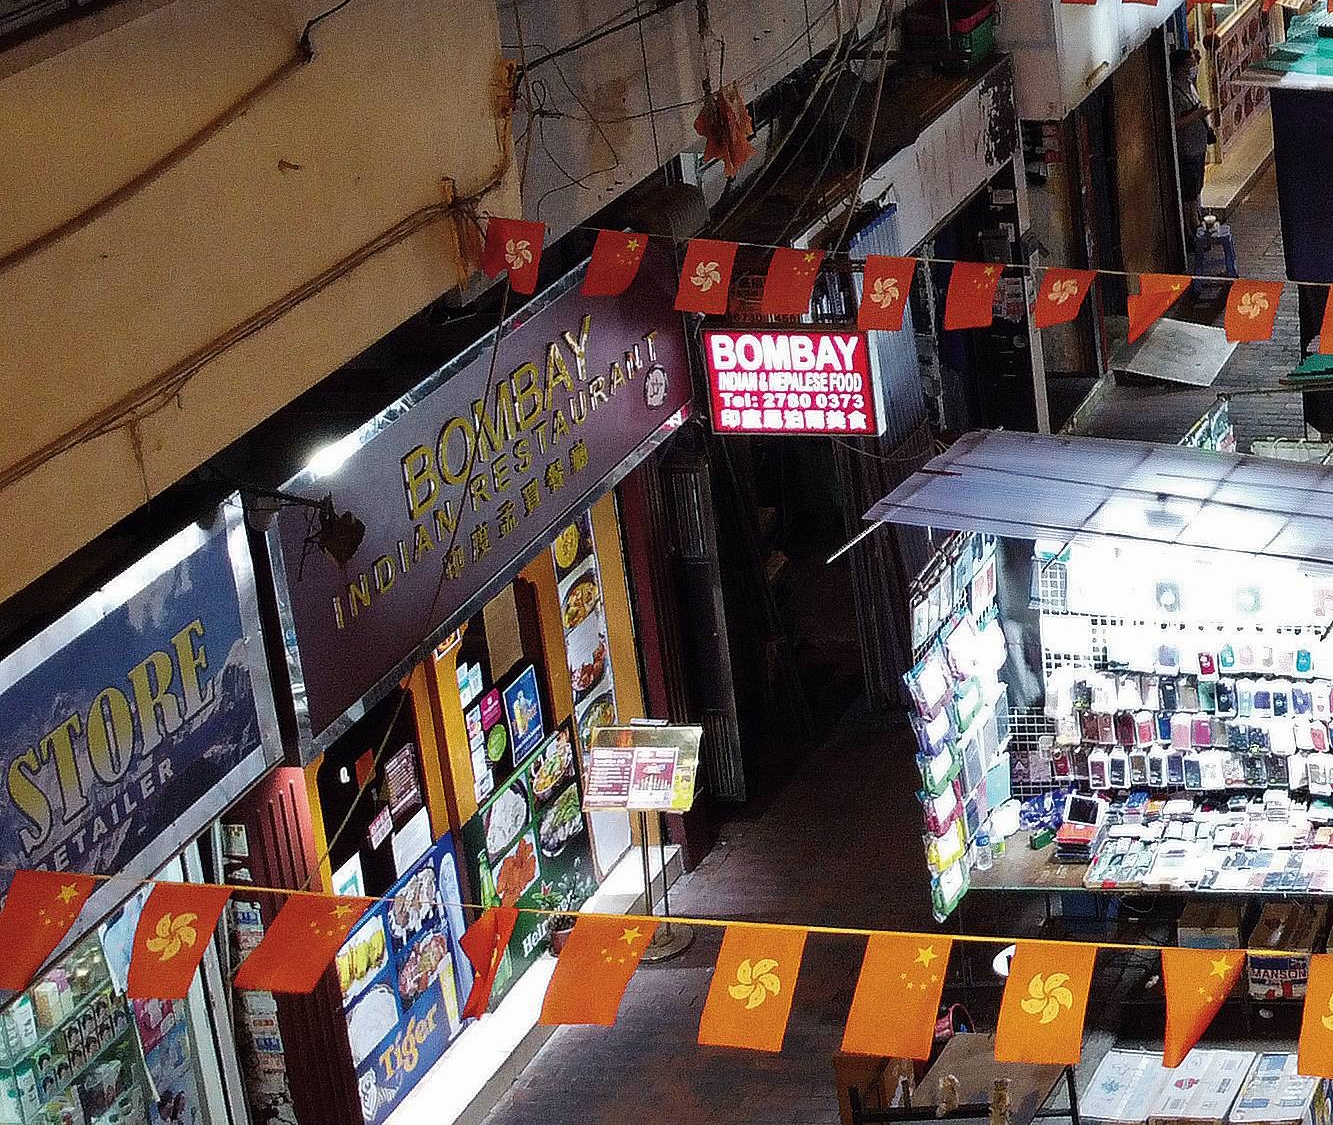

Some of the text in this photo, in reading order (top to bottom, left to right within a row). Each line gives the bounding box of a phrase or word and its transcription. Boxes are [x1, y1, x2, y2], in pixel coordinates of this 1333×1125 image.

[710, 333, 859, 371] BOMBAY
[769, 371, 828, 392] NEPALESE
[829, 372, 863, 392] FOOD
[400, 313, 592, 521] BOMBAY
[719, 392, 758, 408] Tel:
[815, 393, 865, 408] 0373
[332, 329, 658, 629] INDIAN RESTAURANT
[7, 618, 215, 855] STORE
[378, 1003, 438, 1081] Tiger
